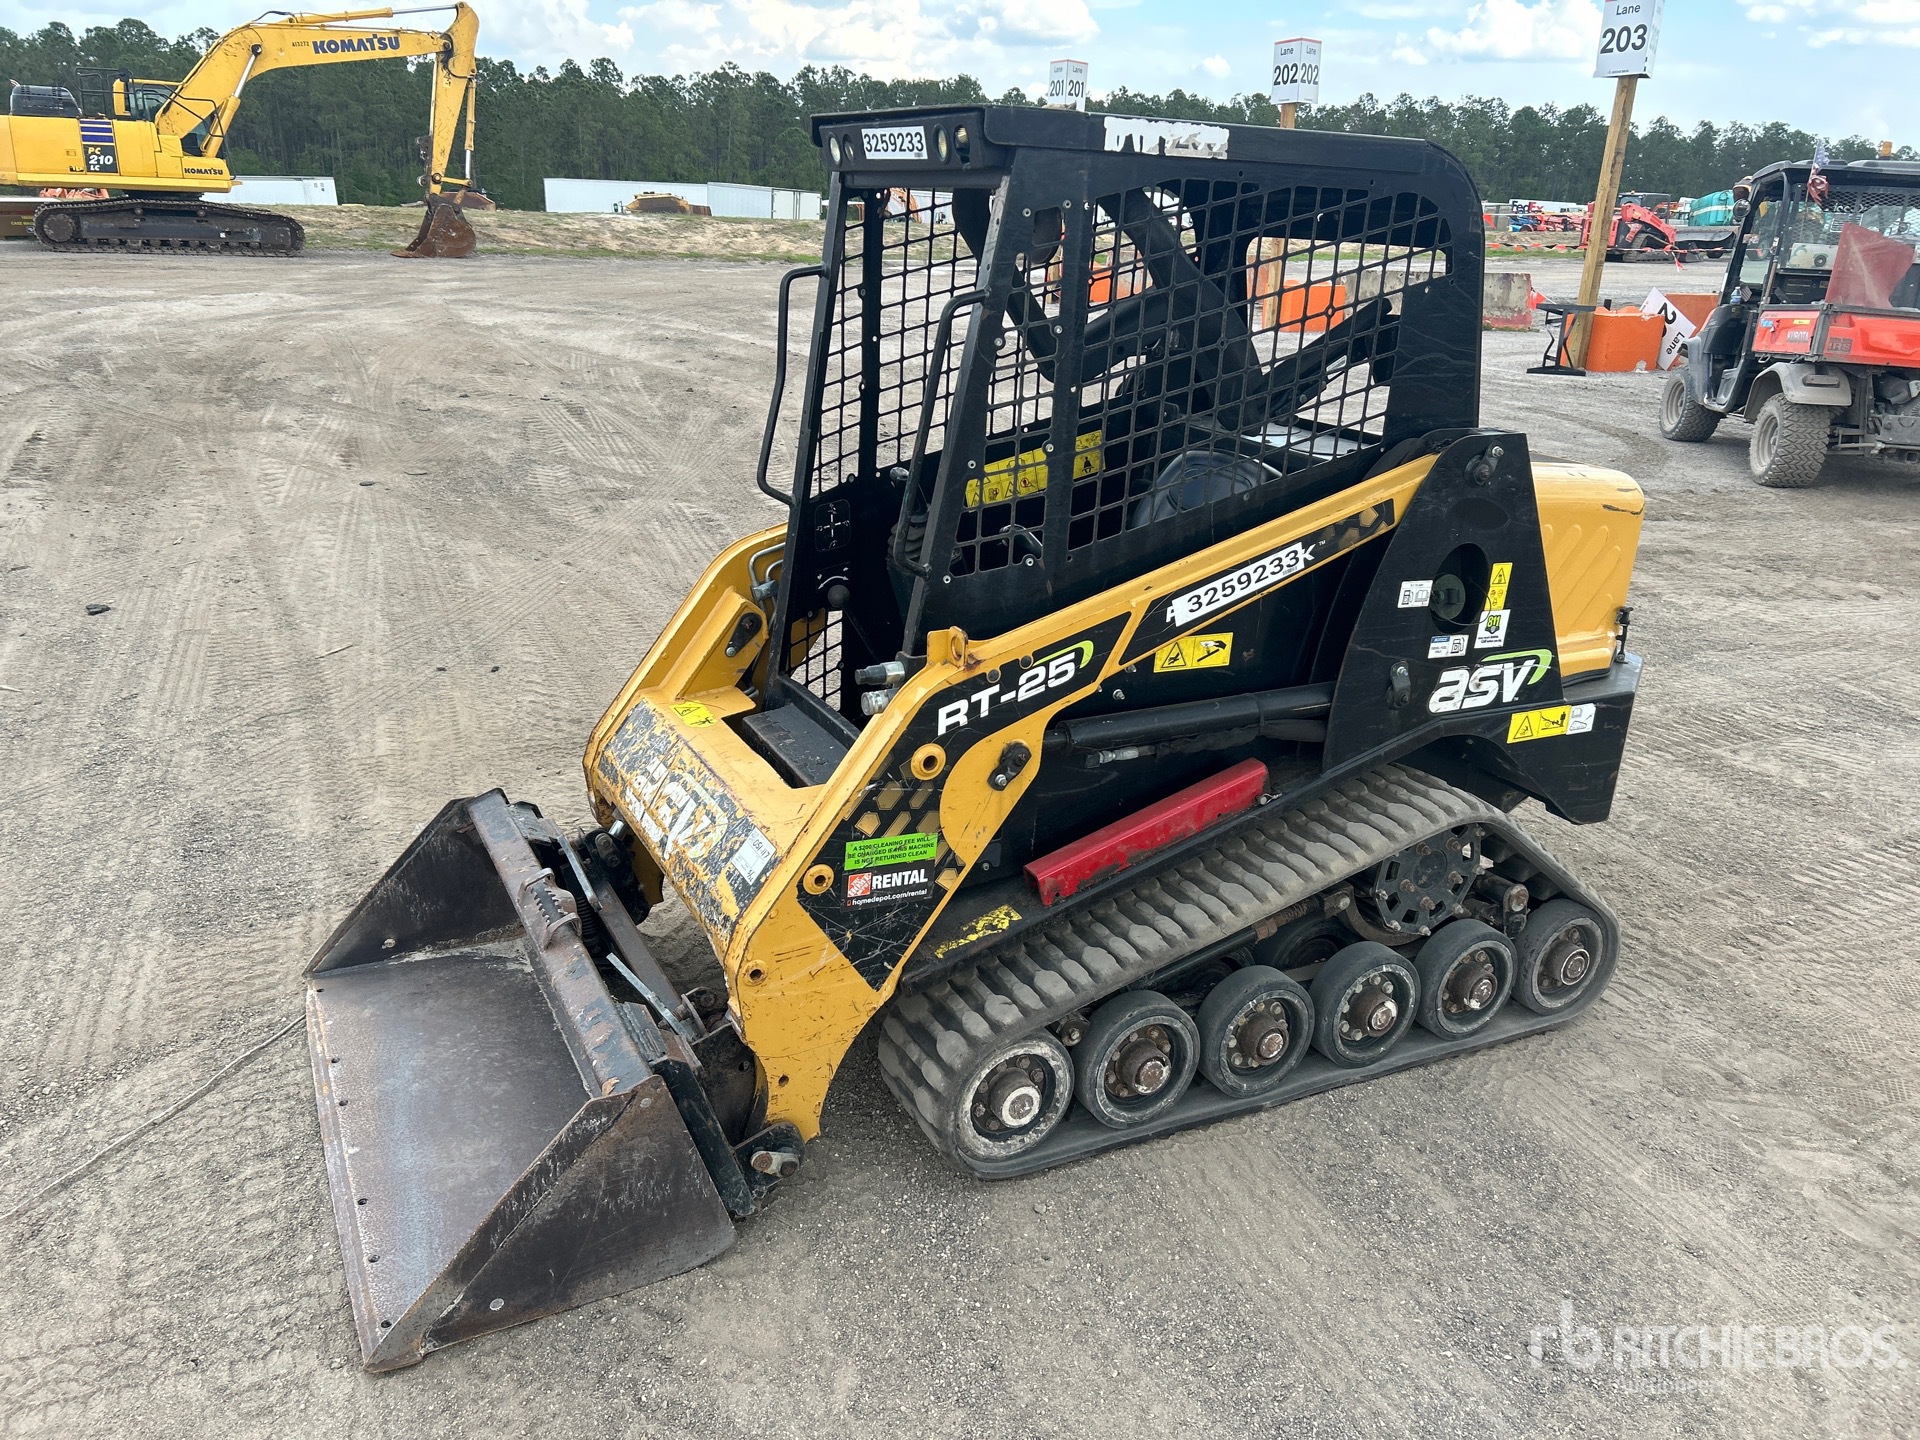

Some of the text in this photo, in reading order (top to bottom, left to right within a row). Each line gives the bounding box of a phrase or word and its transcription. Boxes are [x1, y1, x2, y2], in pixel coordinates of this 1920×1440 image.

[1616, 4, 1641, 16] Lane
[312, 34, 400, 54] KOMATSU
[1600, 24, 1648, 54] 203
[1280, 47, 1294, 56] Lane
[1072, 65, 1083, 74] Lane
[1273, 63, 1298, 86] 202
[1300, 62, 1319, 85] 202
[1050, 79, 1064, 97] 201
[1068, 79, 1084, 98] 201
[88, 146, 101, 154] PC
[863, 131, 924, 153] 3259233
[88, 155, 113, 165] 210
[184, 167, 223, 175] KOMATSU
[1511, 200, 1544, 214] FedEx
[1666, 331, 1685, 355] Lane
[1187, 549, 1300, 613] 3259233
[1487, 614, 1501, 628] 811
[937, 652, 1076, 737] RT-25
[873, 840, 904, 849] CLEANING
[908, 842, 935, 851] MACHINE
[875, 852, 907, 862] RETURNED
[871, 868, 929, 890] RENTAL
[852, 888, 928, 906] homedepot.com/rental
